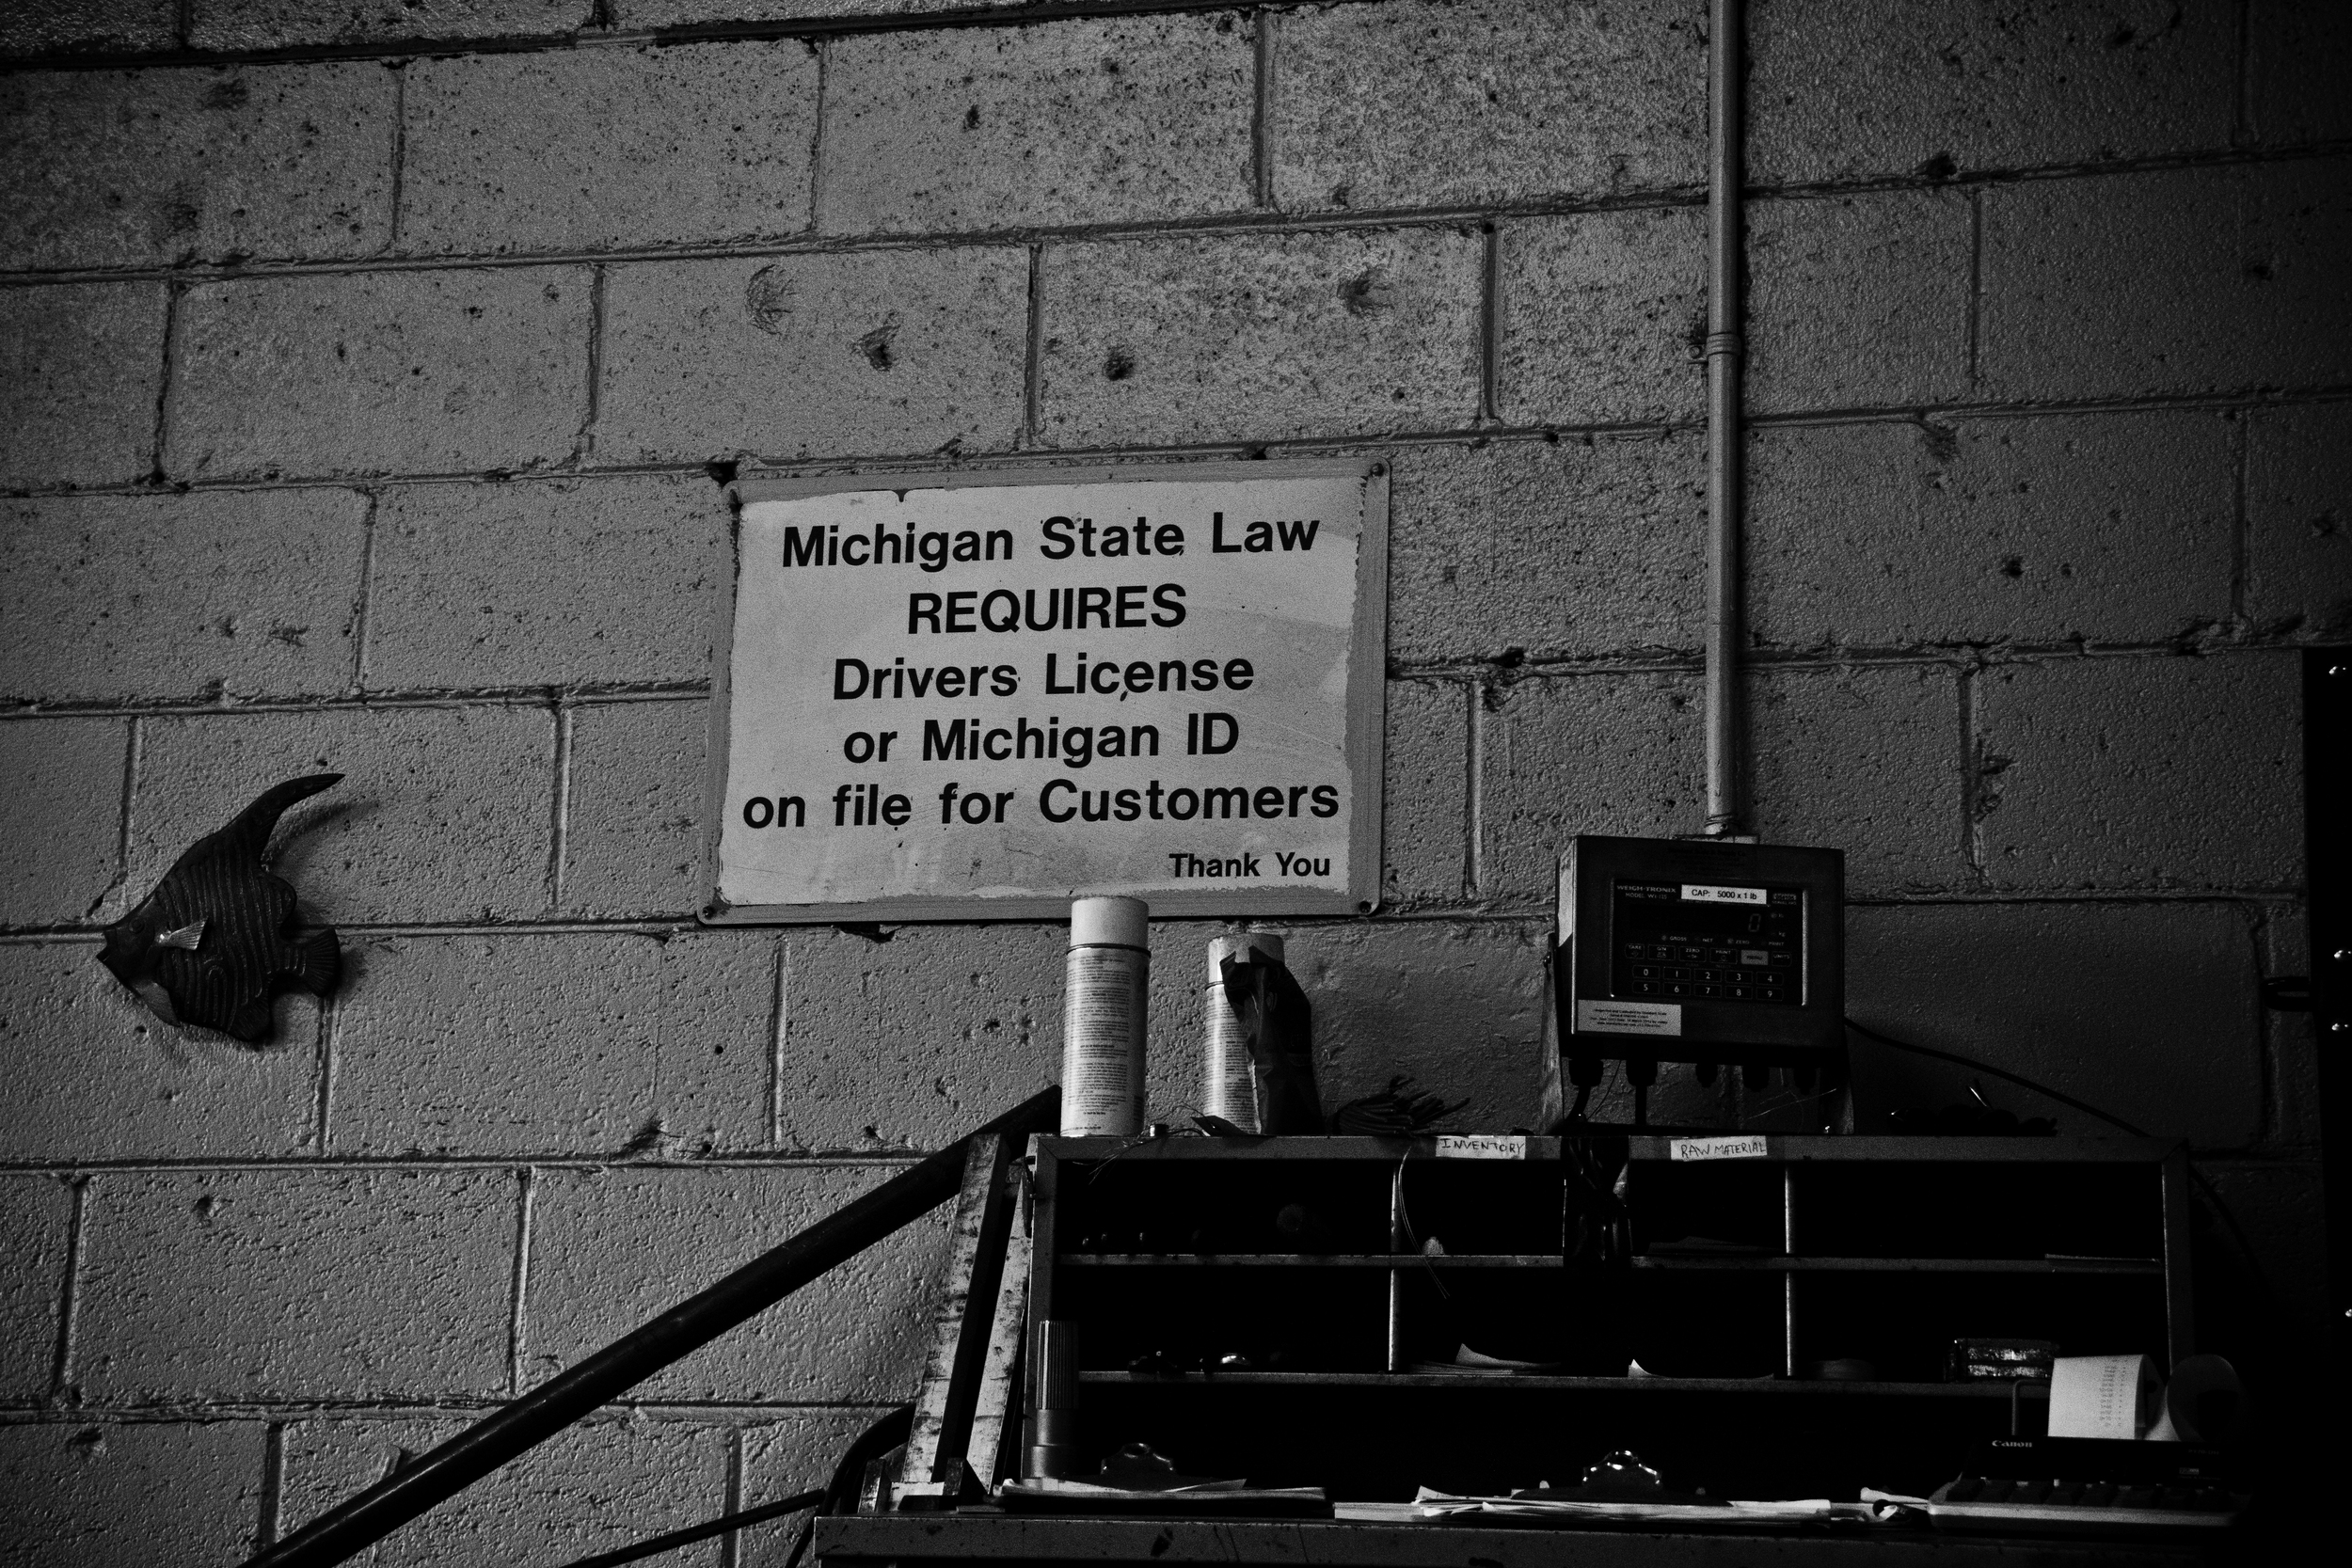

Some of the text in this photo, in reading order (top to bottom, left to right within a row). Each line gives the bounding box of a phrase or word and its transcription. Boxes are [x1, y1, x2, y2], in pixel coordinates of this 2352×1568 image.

[783, 512, 1320, 573] Michigan State Law
[908, 583, 1186, 635] REQUIRES
[834, 652, 1254, 700] Drivers License
[843, 712, 1239, 768] or Michigan ID
[743, 778, 1340, 830] on file for Customers
[1168, 851, 1330, 878] Thank You
[1692, 889, 1710, 897] CAP:
[1717, 890, 1736, 899] 5000
[1750, 892, 1757, 900] lb
[1748, 912, 1761, 933] 0
[1644, 968, 1649, 976] 0
[1705, 972, 1711, 980] 2
[1736, 973, 1741, 981] 3
[1767, 974, 1773, 983] 4
[1644, 983, 1649, 991] 5
[1674, 985, 1680, 993] 6
[1736, 988, 1741, 996] 8
[1767, 990, 1773, 998] 9
[1440, 1137, 1525, 1153] INVENTORY
[1680, 1141, 1767, 1158] RAW MATERIAL
[1991, 1439, 2033, 1449] Canon
